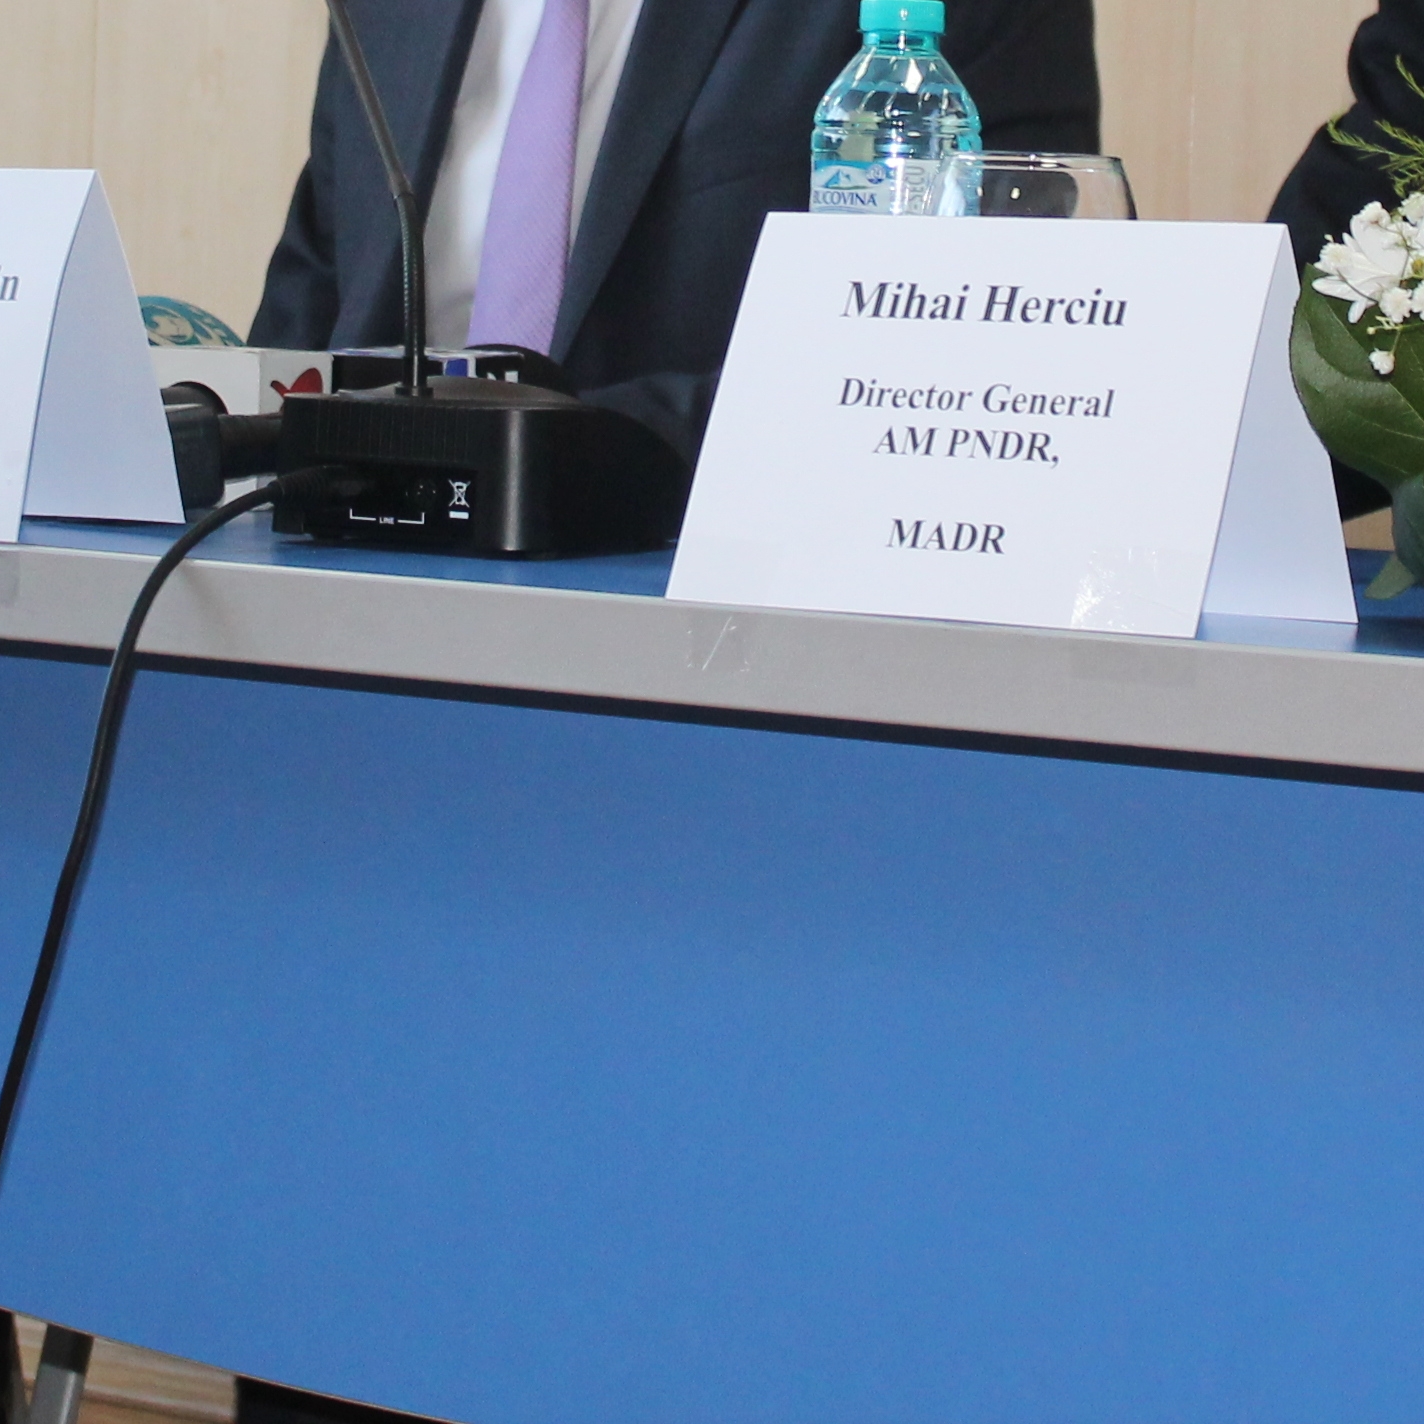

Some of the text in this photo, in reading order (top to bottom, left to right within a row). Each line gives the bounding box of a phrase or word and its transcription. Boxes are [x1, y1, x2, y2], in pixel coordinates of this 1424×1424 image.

[839, 280, 1128, 328] Mihai Herciu
[837, 377, 1117, 420] Director General
[872, 426, 1062, 468] AM PNDR,
[885, 518, 1007, 555] MADR
